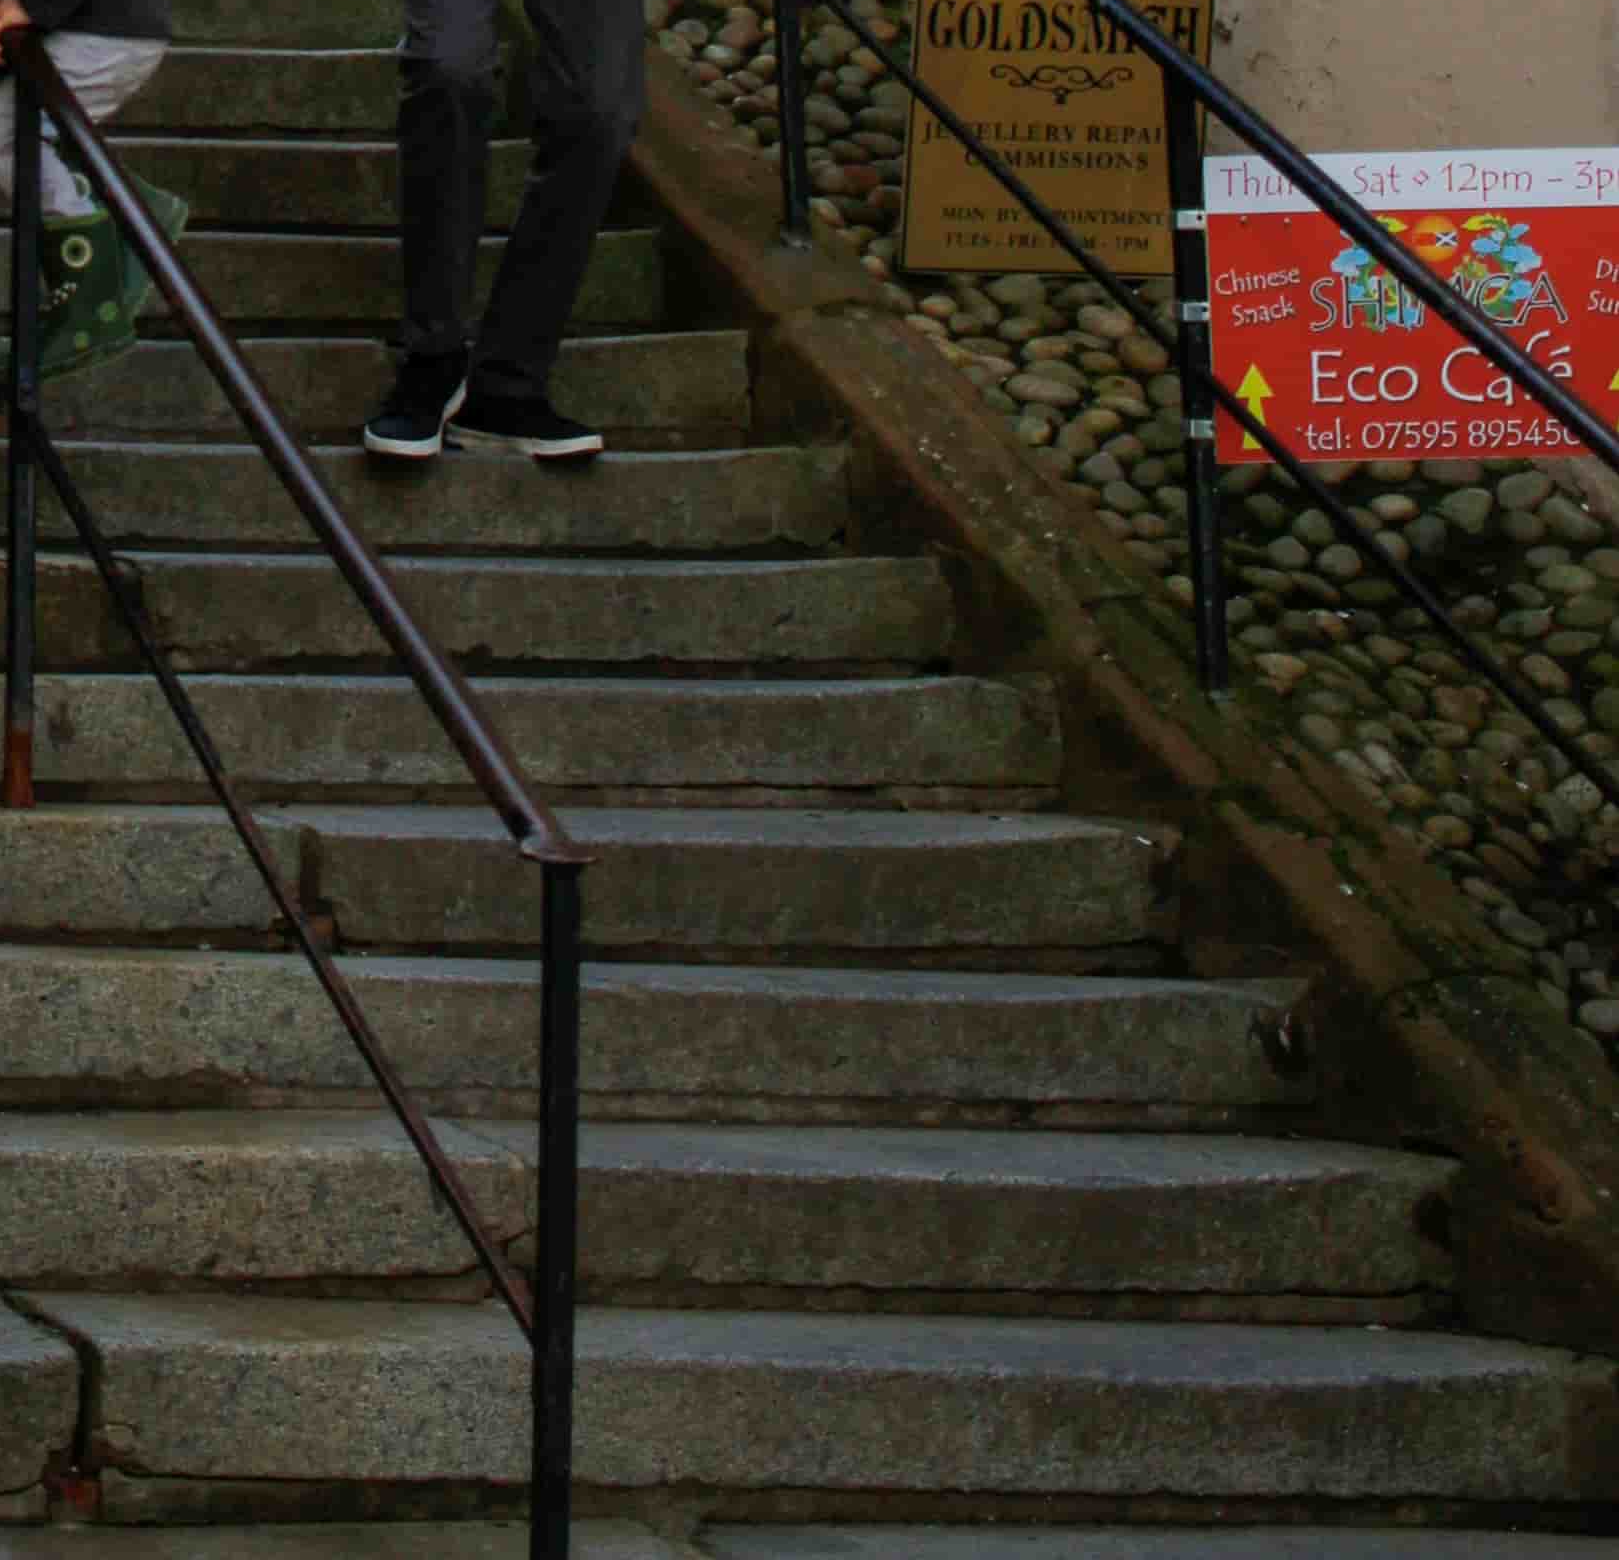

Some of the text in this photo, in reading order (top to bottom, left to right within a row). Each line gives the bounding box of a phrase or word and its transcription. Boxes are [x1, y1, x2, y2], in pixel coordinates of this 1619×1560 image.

[1353, 164, 1401, 196] Sat
[1442, 160, 1533, 203] 12pm
[1214, 266, 1302, 297] Chinese
[1231, 297, 1297, 328] Snack
[1309, 349, 1420, 404] Eco
[1303, 417, 1352, 450] tel:
[1361, 420, 1458, 450] 07595
